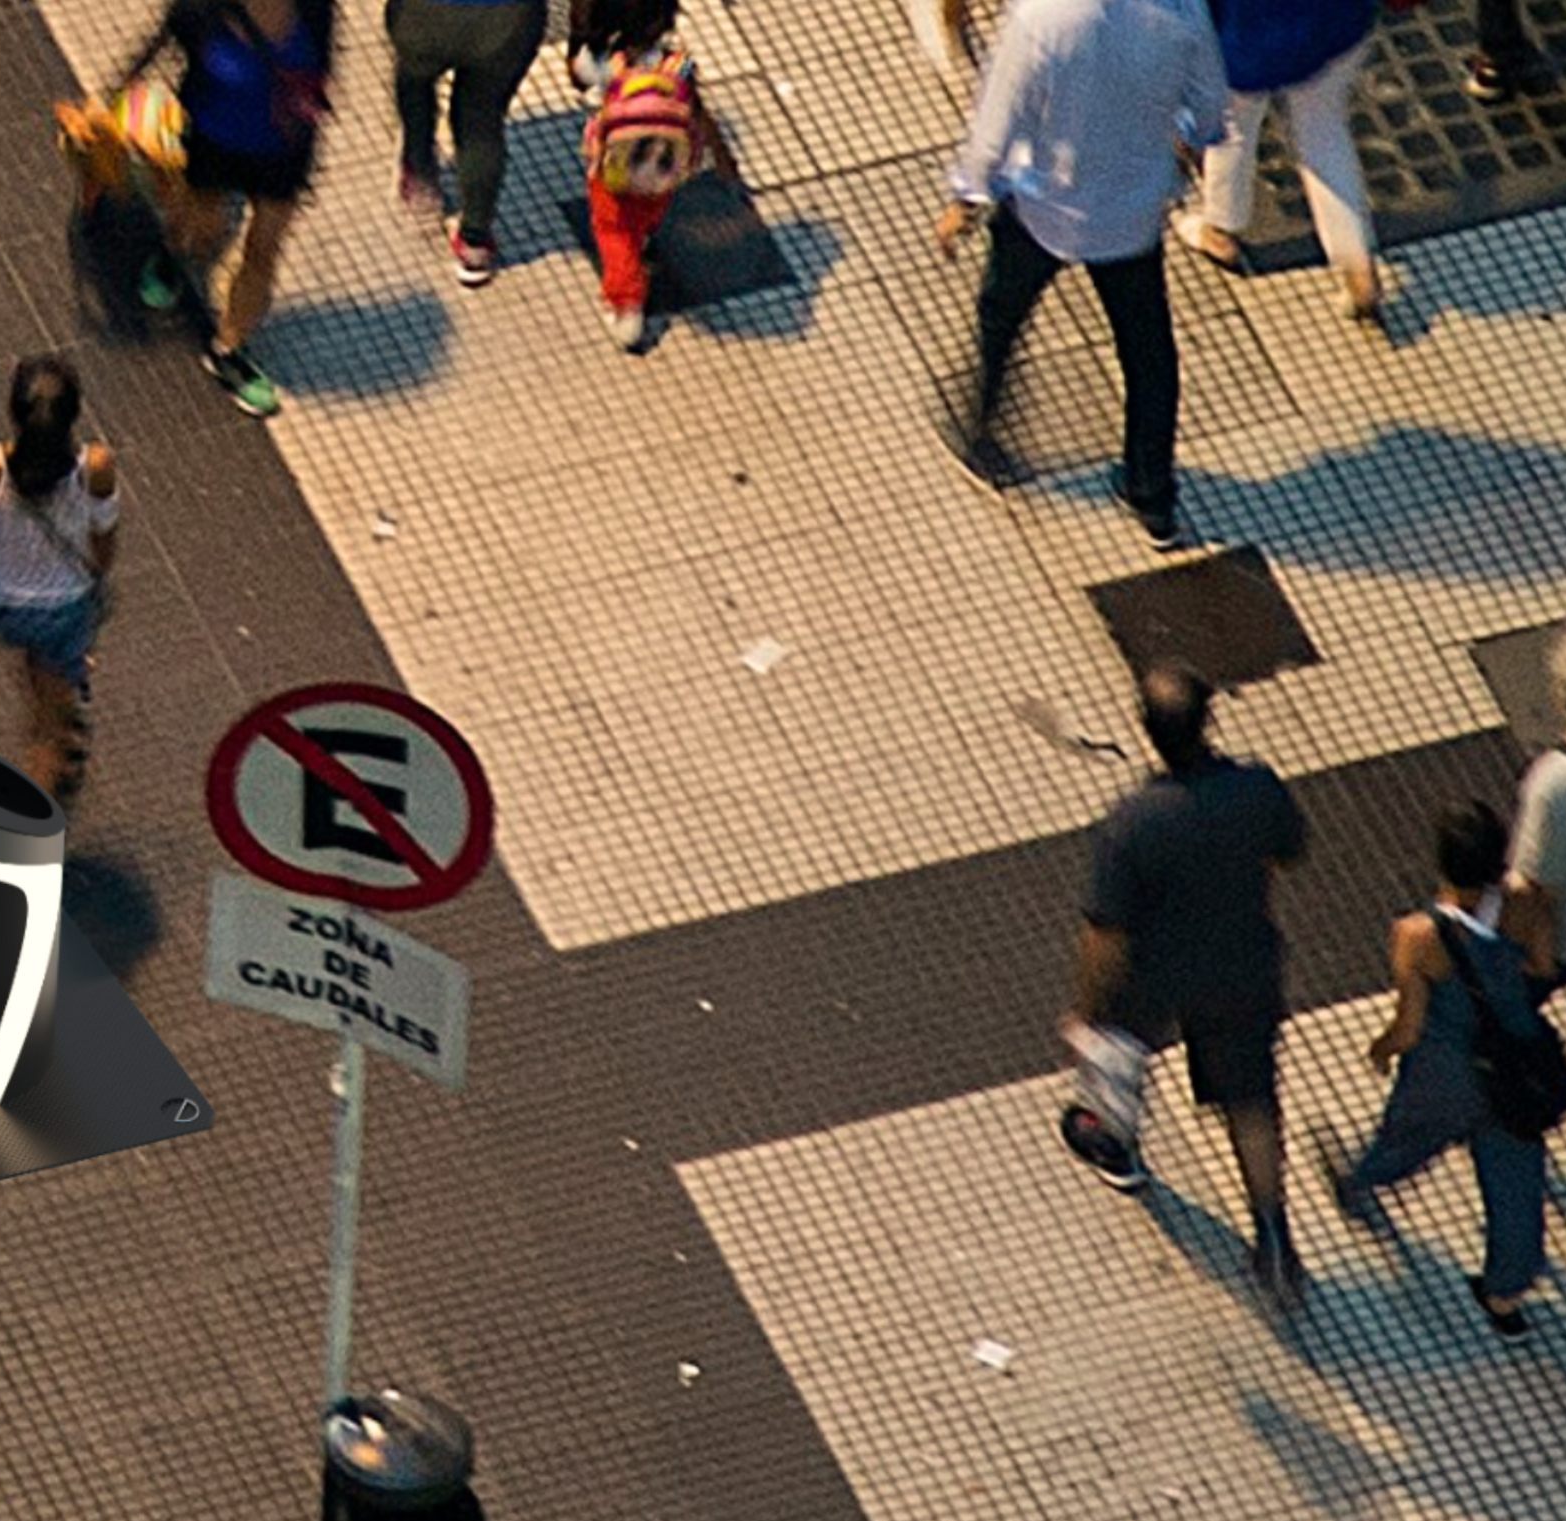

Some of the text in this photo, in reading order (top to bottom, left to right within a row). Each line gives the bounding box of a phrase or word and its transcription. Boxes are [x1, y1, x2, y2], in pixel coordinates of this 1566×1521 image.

[303, 728, 408, 865] E
[288, 905, 393, 969] ZONA
[324, 949, 371, 990] DE
[239, 961, 439, 1055] CAUDALES
